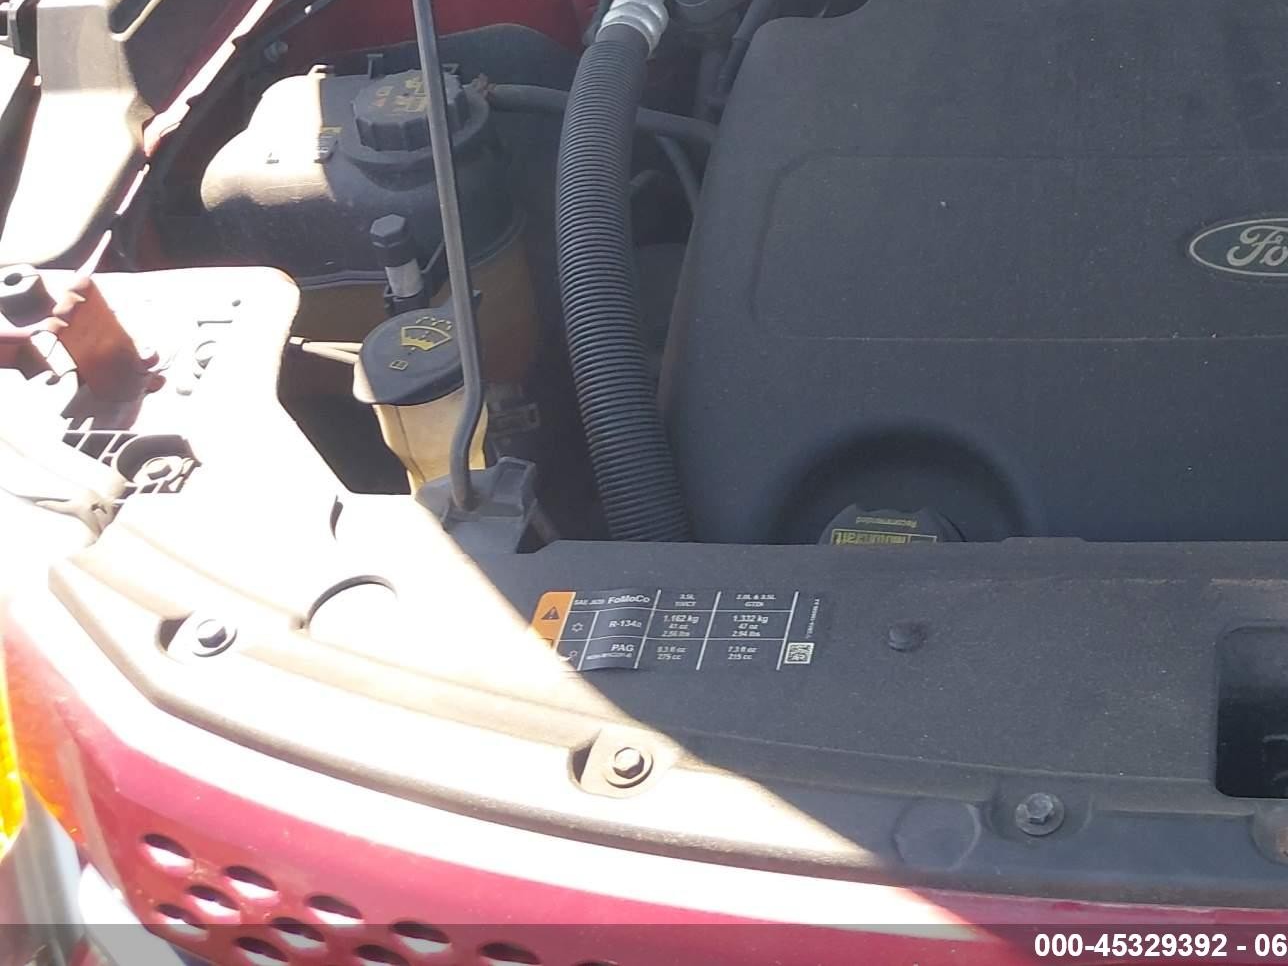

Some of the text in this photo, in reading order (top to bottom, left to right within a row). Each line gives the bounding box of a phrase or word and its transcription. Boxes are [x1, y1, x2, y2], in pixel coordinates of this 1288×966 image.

[607, 594, 651, 604] FoMoCo
[608, 619, 642, 628] R-134a
[663, 614, 700, 624] 1.162 kg
[757, 614, 769, 624] kg
[610, 644, 635, 652] PAG
